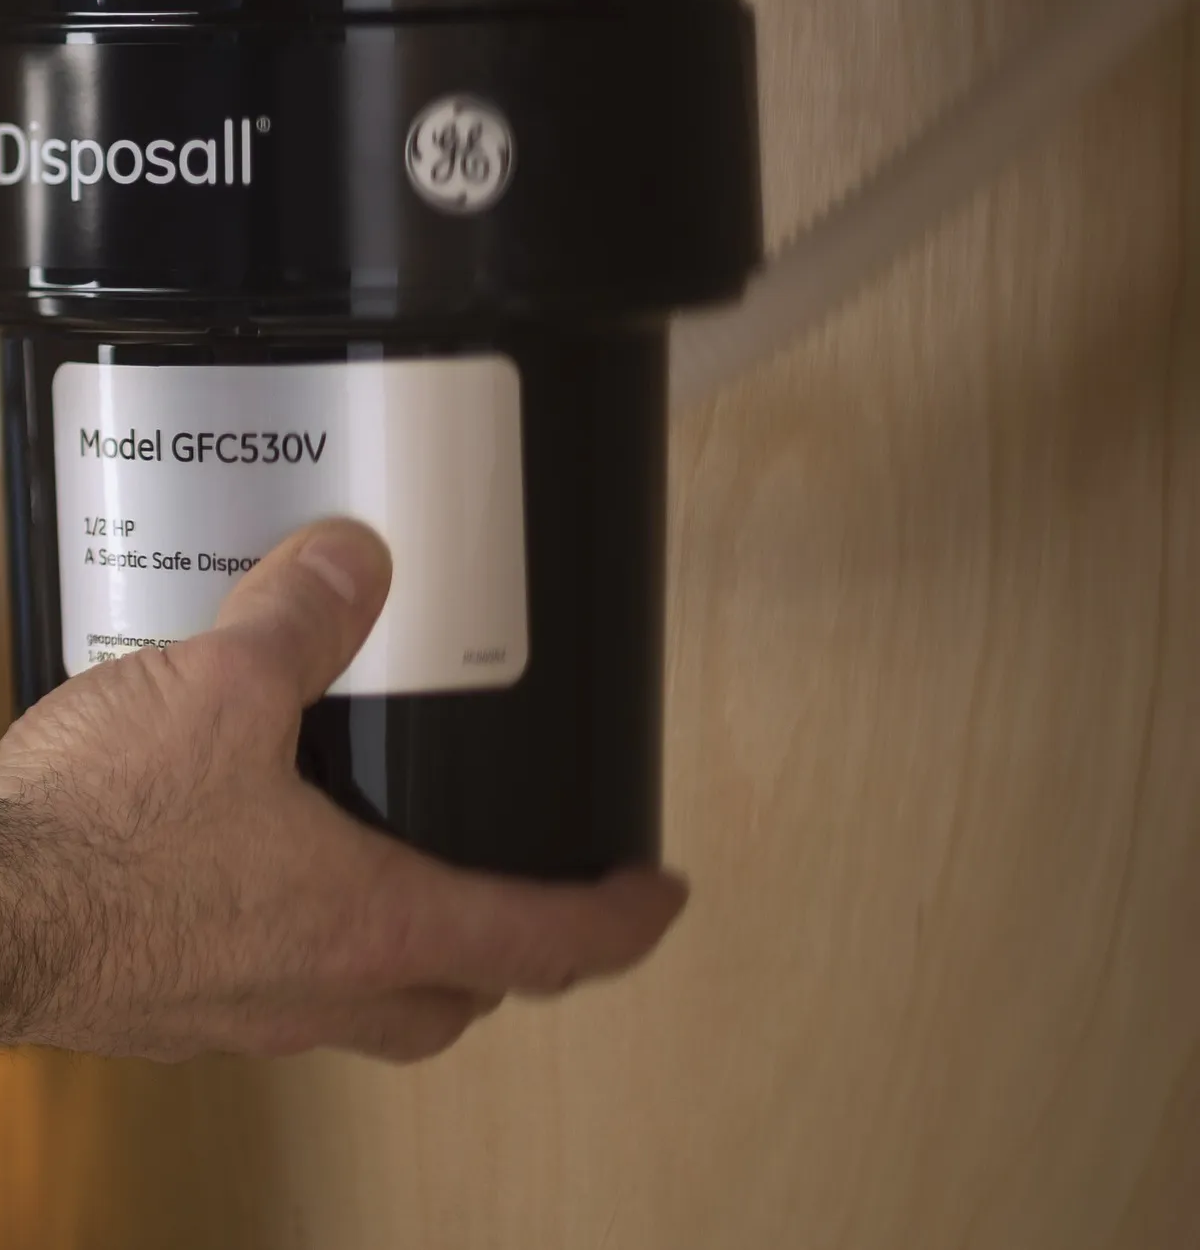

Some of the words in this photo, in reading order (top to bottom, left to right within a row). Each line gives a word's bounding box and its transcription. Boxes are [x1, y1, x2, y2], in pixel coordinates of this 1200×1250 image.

[79, 428, 162, 462] Model
[171, 431, 327, 464] GFC530V
[84, 517, 107, 536] 1/2
[113, 519, 135, 537] HP
[84, 548, 95, 565] A
[98, 548, 147, 571] Septic
[152, 551, 192, 570] Safe
[86, 634, 178, 649] geappliances.co
